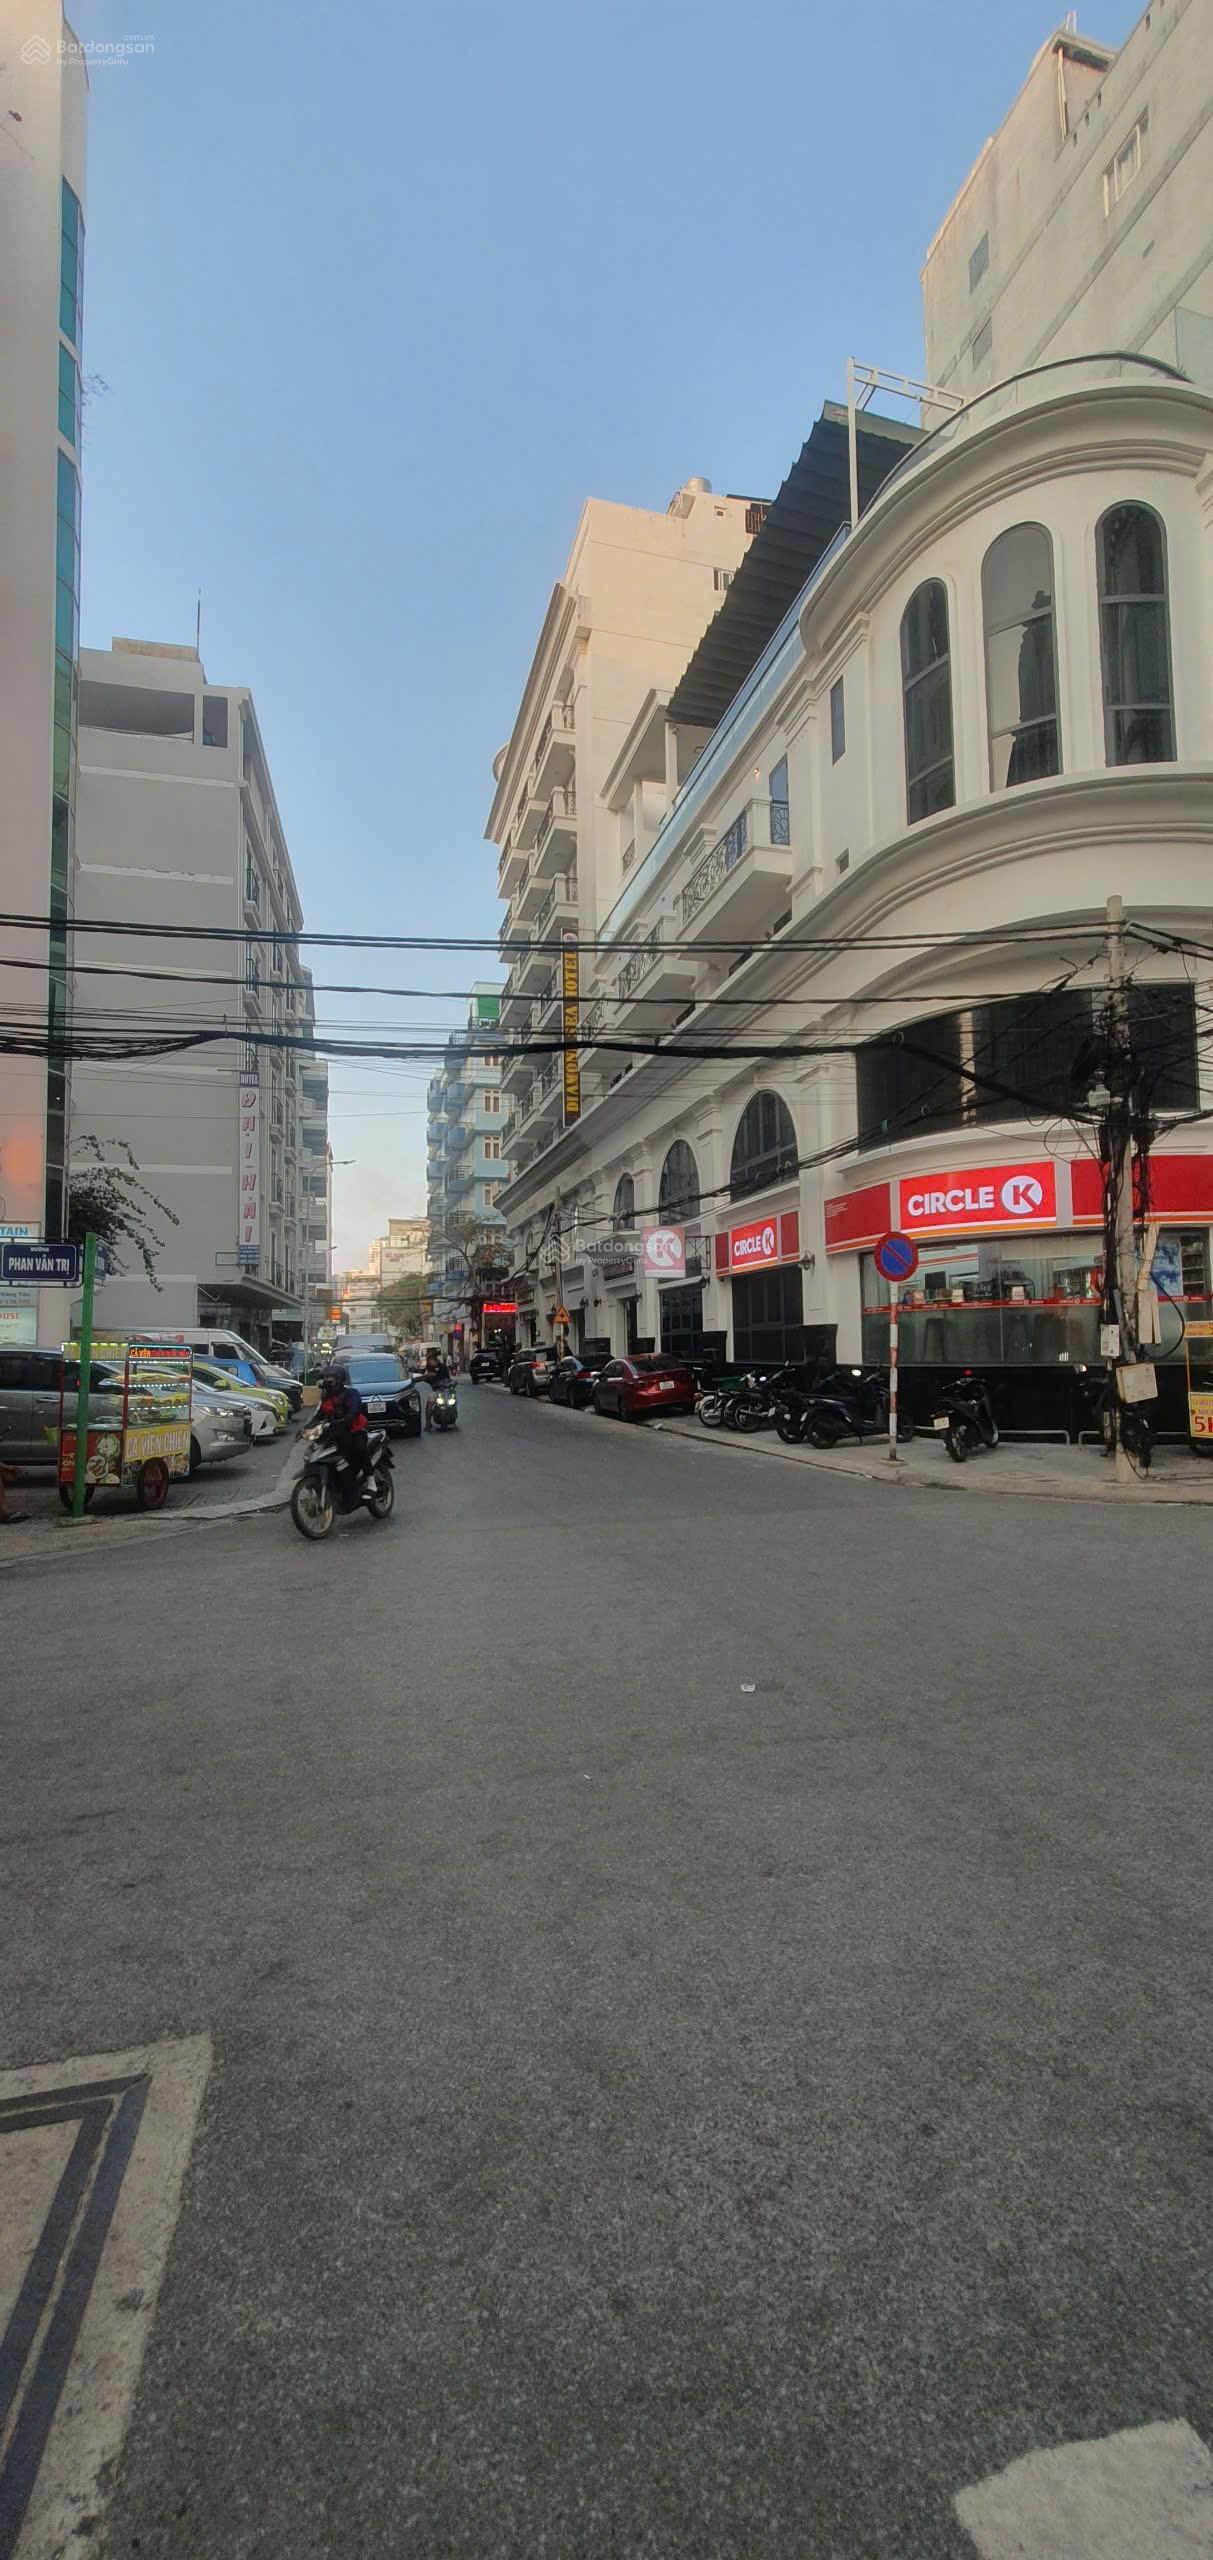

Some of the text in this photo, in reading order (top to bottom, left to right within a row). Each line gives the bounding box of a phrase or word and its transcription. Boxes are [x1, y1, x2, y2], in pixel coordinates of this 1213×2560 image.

[907, 1186, 995, 1217] CIRCLE
[734, 1235, 762, 1257] CIRCLE
[8, 1254, 70, 1275] PHAN VĂN TRỊ
